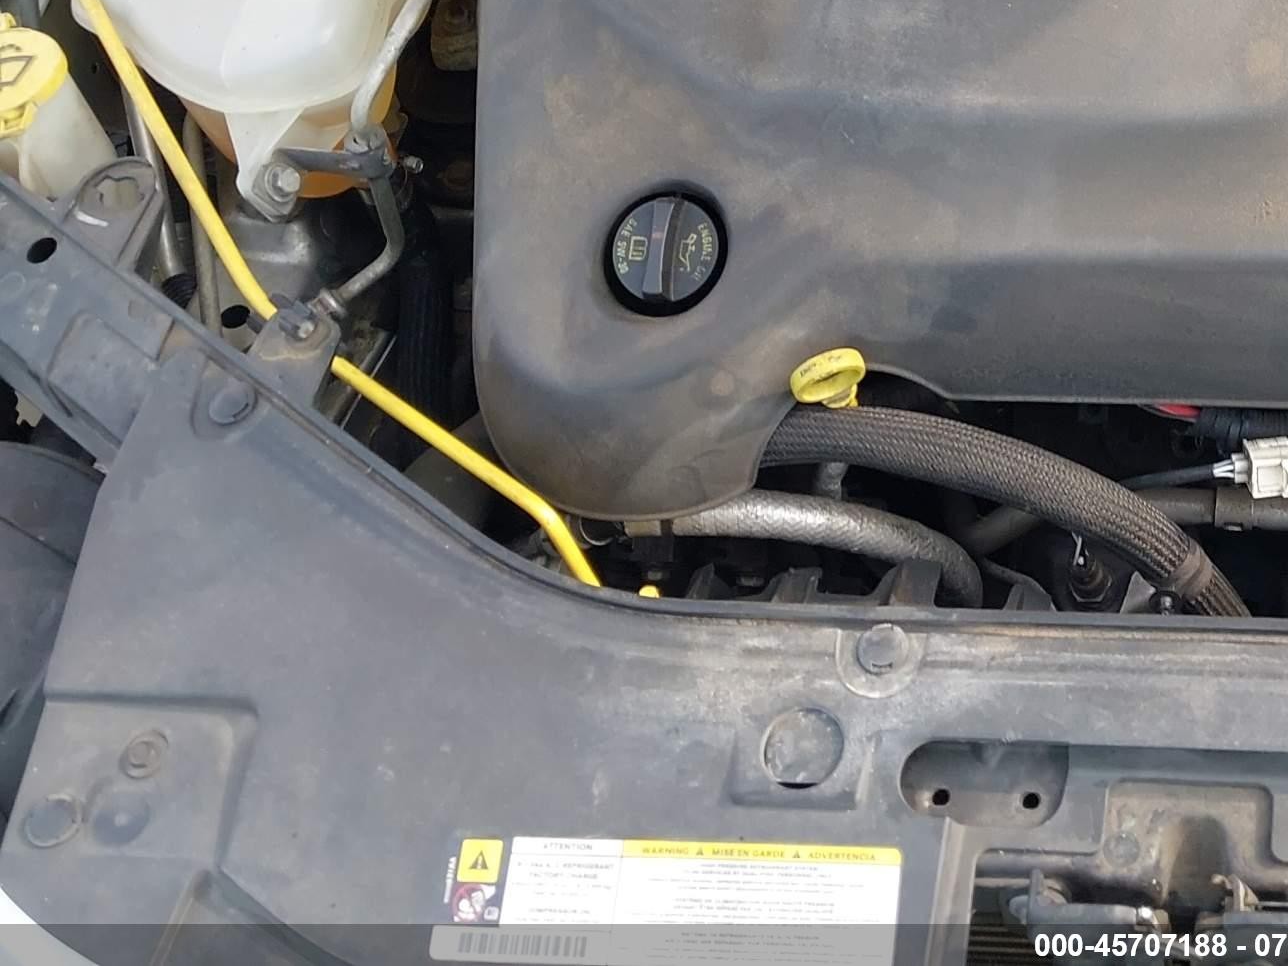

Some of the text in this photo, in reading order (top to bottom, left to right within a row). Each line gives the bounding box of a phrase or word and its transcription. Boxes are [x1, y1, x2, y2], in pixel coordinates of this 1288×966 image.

[543, 843, 593, 851] ATTENTION
[642, 846, 690, 856] WARNING
[711, 847, 736, 857] MISE
[752, 849, 786, 859] GARDE
[808, 851, 877, 862] ADVERTENCIA
